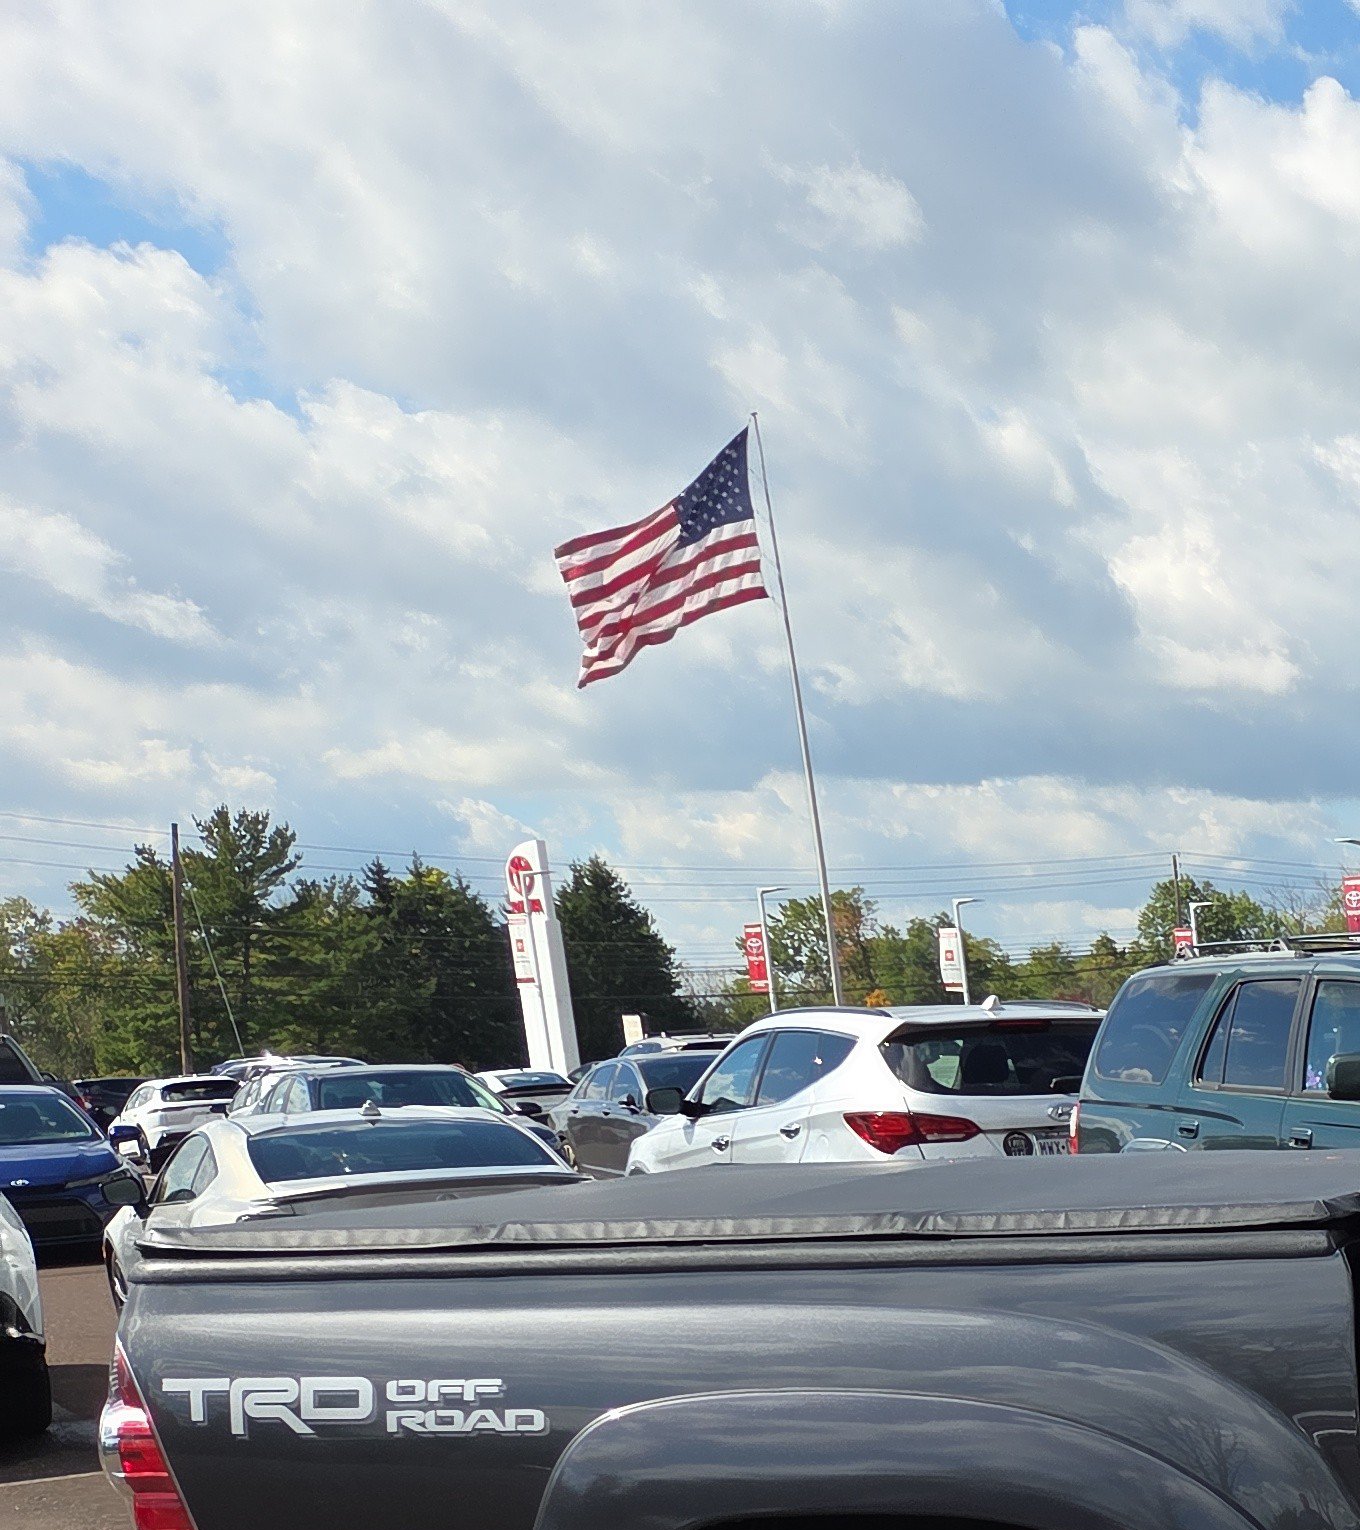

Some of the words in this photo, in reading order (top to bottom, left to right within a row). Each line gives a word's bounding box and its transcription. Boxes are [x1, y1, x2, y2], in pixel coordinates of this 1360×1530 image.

[386, 1378, 503, 1402] OFF
[161, 1376, 376, 1437] TRD
[386, 1408, 546, 1433] ROAD
